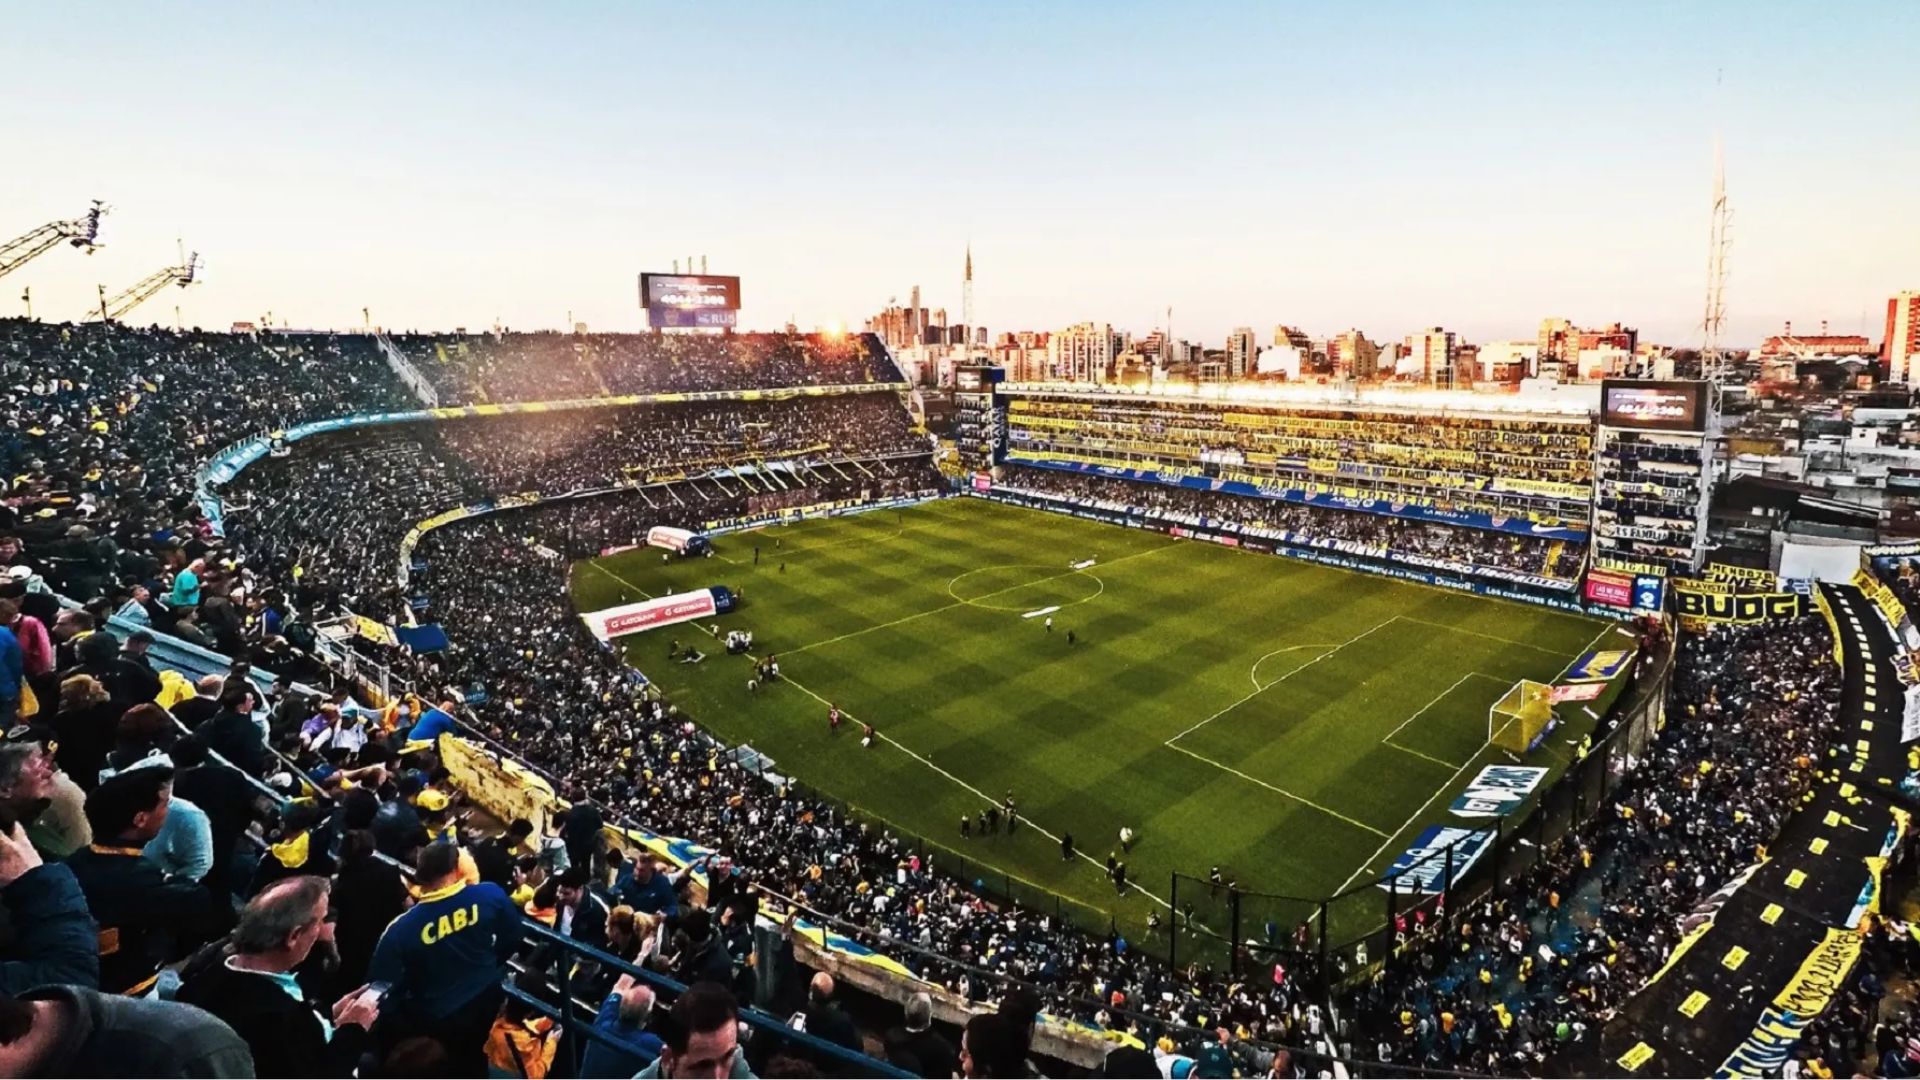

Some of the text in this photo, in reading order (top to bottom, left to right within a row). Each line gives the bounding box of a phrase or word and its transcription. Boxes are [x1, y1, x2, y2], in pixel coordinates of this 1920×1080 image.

[1546, 434, 1578, 448] BOCA
[1220, 521, 1239, 533] LA
[1239, 524, 1288, 541] NUEVA
[1309, 536, 1331, 549] LA
[1333, 538, 1388, 559] NUEVA
[1711, 562, 1774, 581] MENDOZA
[1548, 597, 1559, 607] de
[420, 903, 479, 945] CABJ
